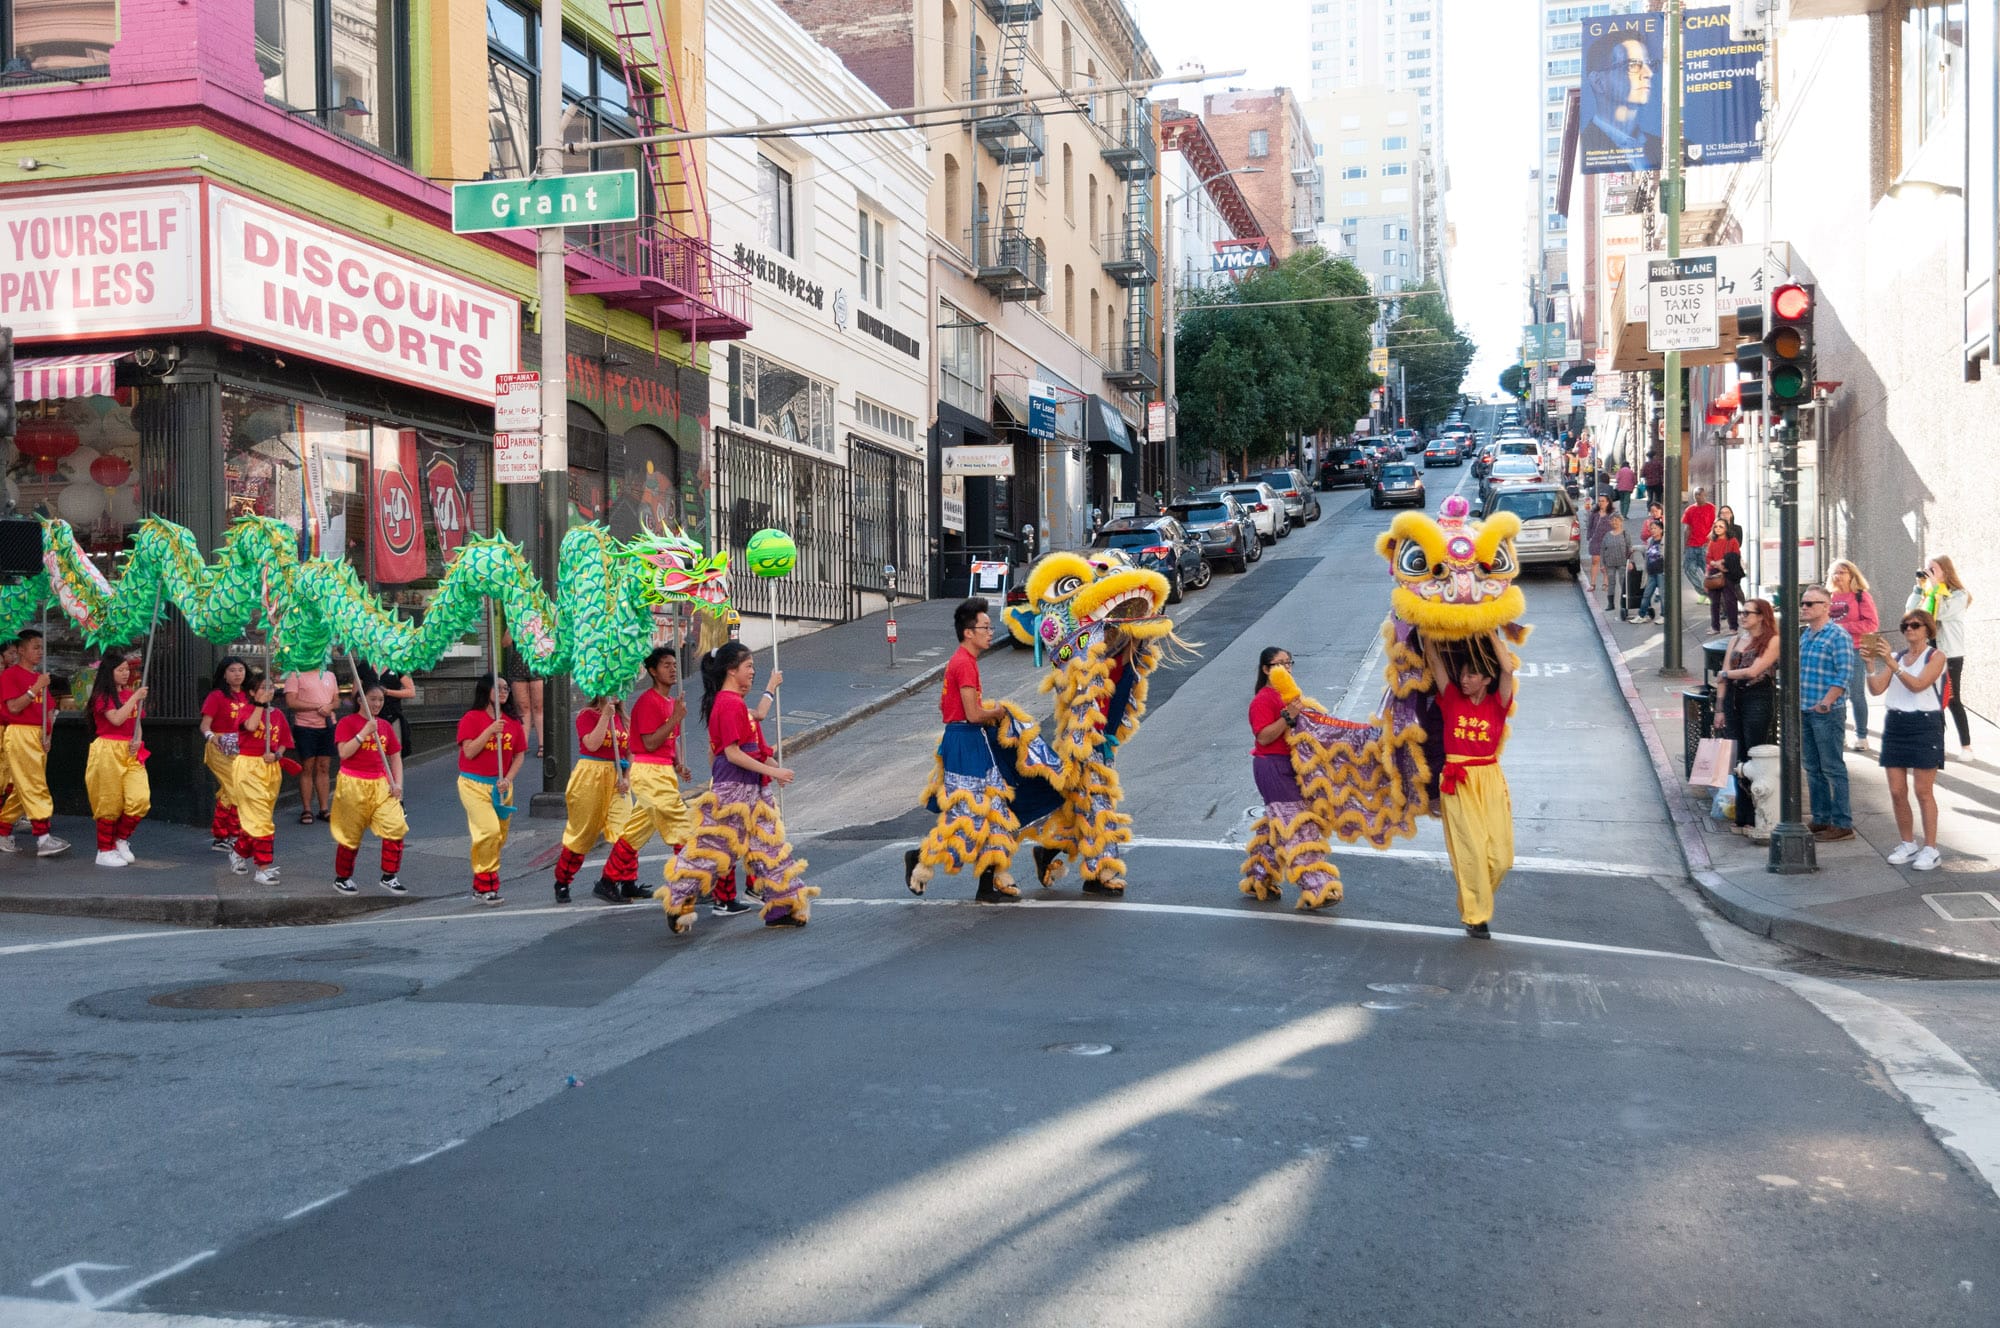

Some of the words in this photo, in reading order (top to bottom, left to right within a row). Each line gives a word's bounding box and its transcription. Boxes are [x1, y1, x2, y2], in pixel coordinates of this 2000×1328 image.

[1589, 19, 1656, 37] GAME
[1685, 13, 1730, 30] CHAN
[1686, 43, 1765, 59] EMPOWERING
[1686, 60, 1709, 70] THE
[1686, 69, 1754, 82] HOMETOWN
[1686, 81, 1732, 93] HEROES
[1718, 141, 1748, 150] Hastings
[491, 186, 598, 218] Grant
[8, 207, 178, 261] YOURSELF
[1214, 251, 1267, 269] YMCA
[1651, 264, 1681, 277] RIGHT
[1684, 263, 1713, 275] LANE
[0, 269, 60, 313] PAY
[71, 261, 156, 308] LESS
[243, 221, 496, 340] DISCOUNT
[1660, 283, 1704, 297] BUSES
[1665, 298, 1700, 312] TAXIS
[1665, 312, 1699, 326] ONLY
[263, 281, 484, 380] IMPORTS
[499, 373, 535, 382] TOW-AWAY
[497, 382, 509, 394] NO
[510, 382, 538, 392] STOPPING
[1033, 400, 1041, 410] For
[1042, 402, 1055, 414] Lease
[496, 434, 508, 448] NO
[510, 438, 537, 447] PARKING
